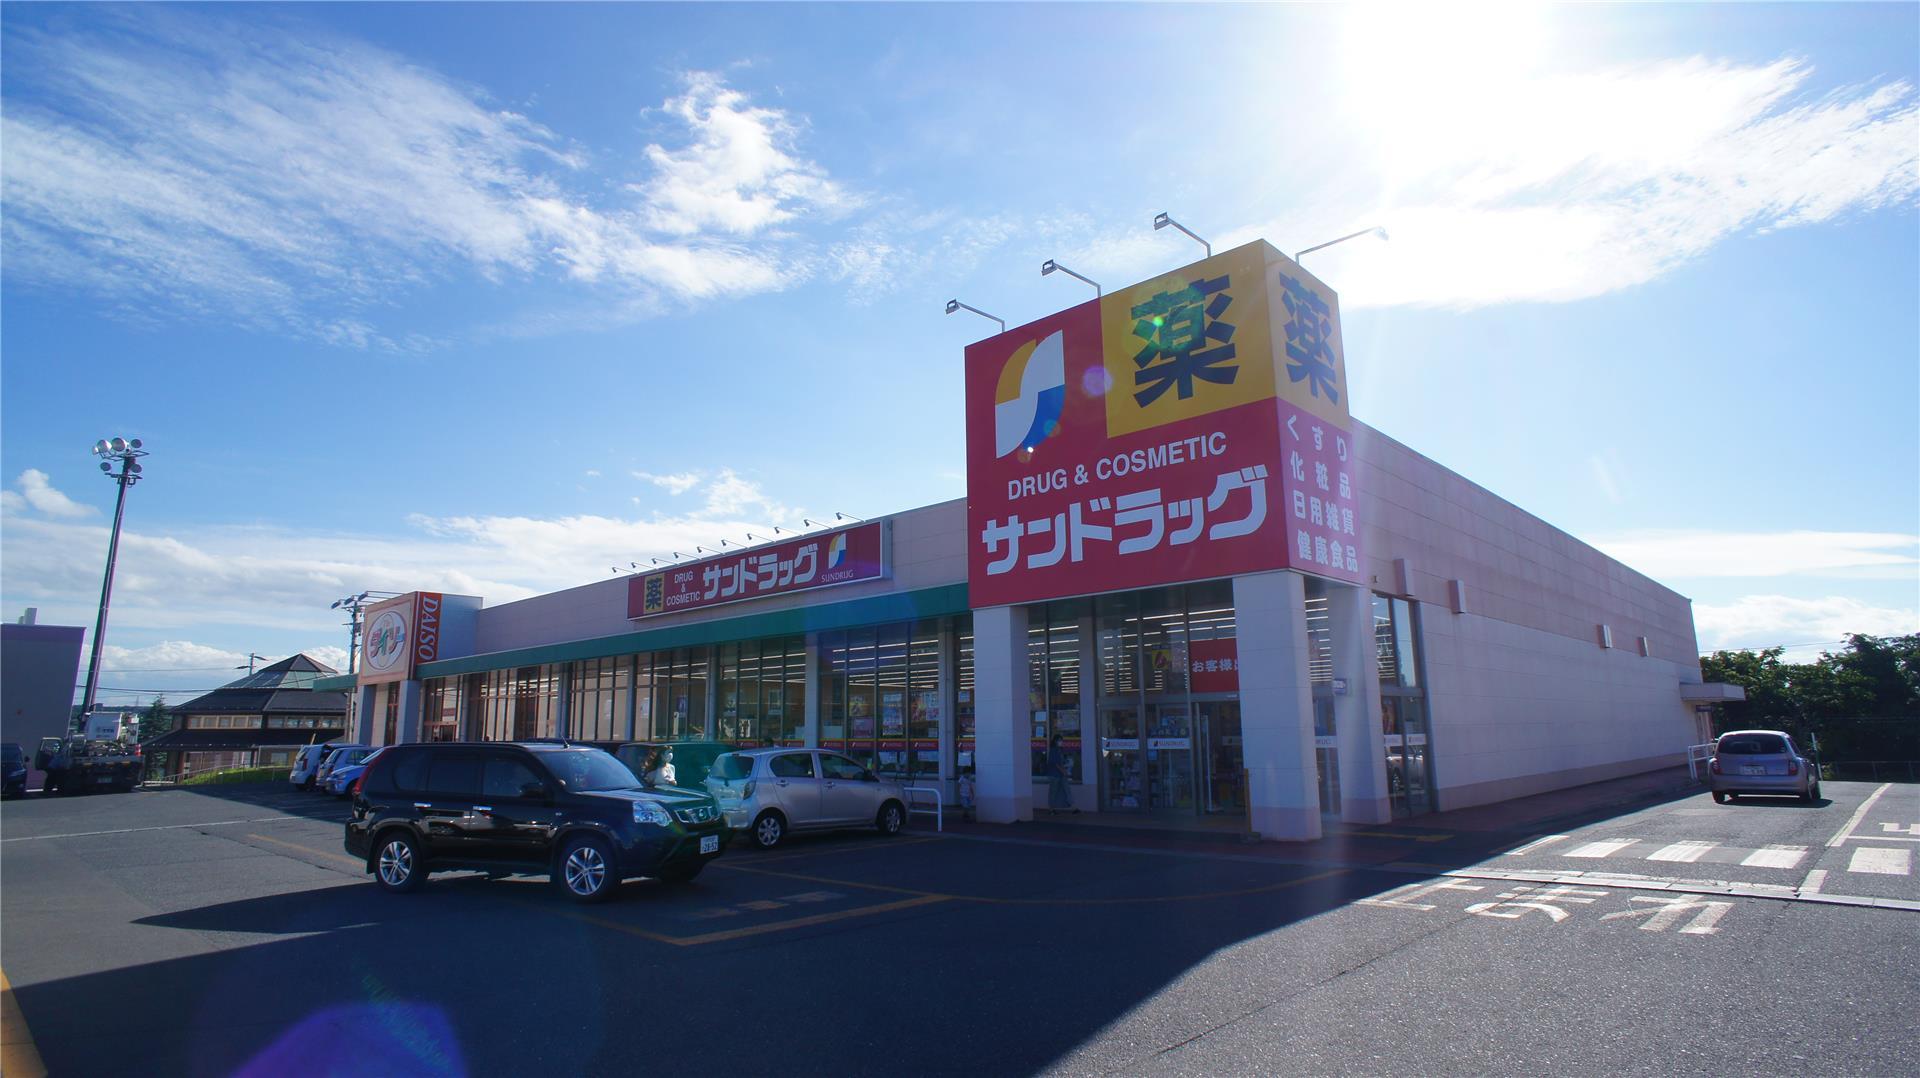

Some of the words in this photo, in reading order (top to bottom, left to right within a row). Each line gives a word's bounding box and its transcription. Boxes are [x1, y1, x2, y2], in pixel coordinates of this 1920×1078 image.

[1130, 273, 1240, 409] 薬
[1279, 271, 1339, 406] 薬
[1287, 414, 1347, 462] くすり
[1008, 468, 1068, 500] DRUG
[1074, 464, 1089, 484] &
[1096, 431, 1227, 481] COSMETIC
[1290, 450, 1352, 500] 化粧品
[982, 463, 1269, 576] サンドラッグ
[1293, 489, 1356, 537] 日用雑貨
[702, 543, 818, 600] サンドラッグ
[1297, 528, 1359, 573] 健康食品
[646, 576, 663, 610] 薬
[666, 591, 700, 607] COSMETIC
[674, 570, 694, 584] DRUG
[681, 583, 686, 593] &
[821, 569, 854, 583] SUNDRUG
[418, 596, 439, 660] DAISO
